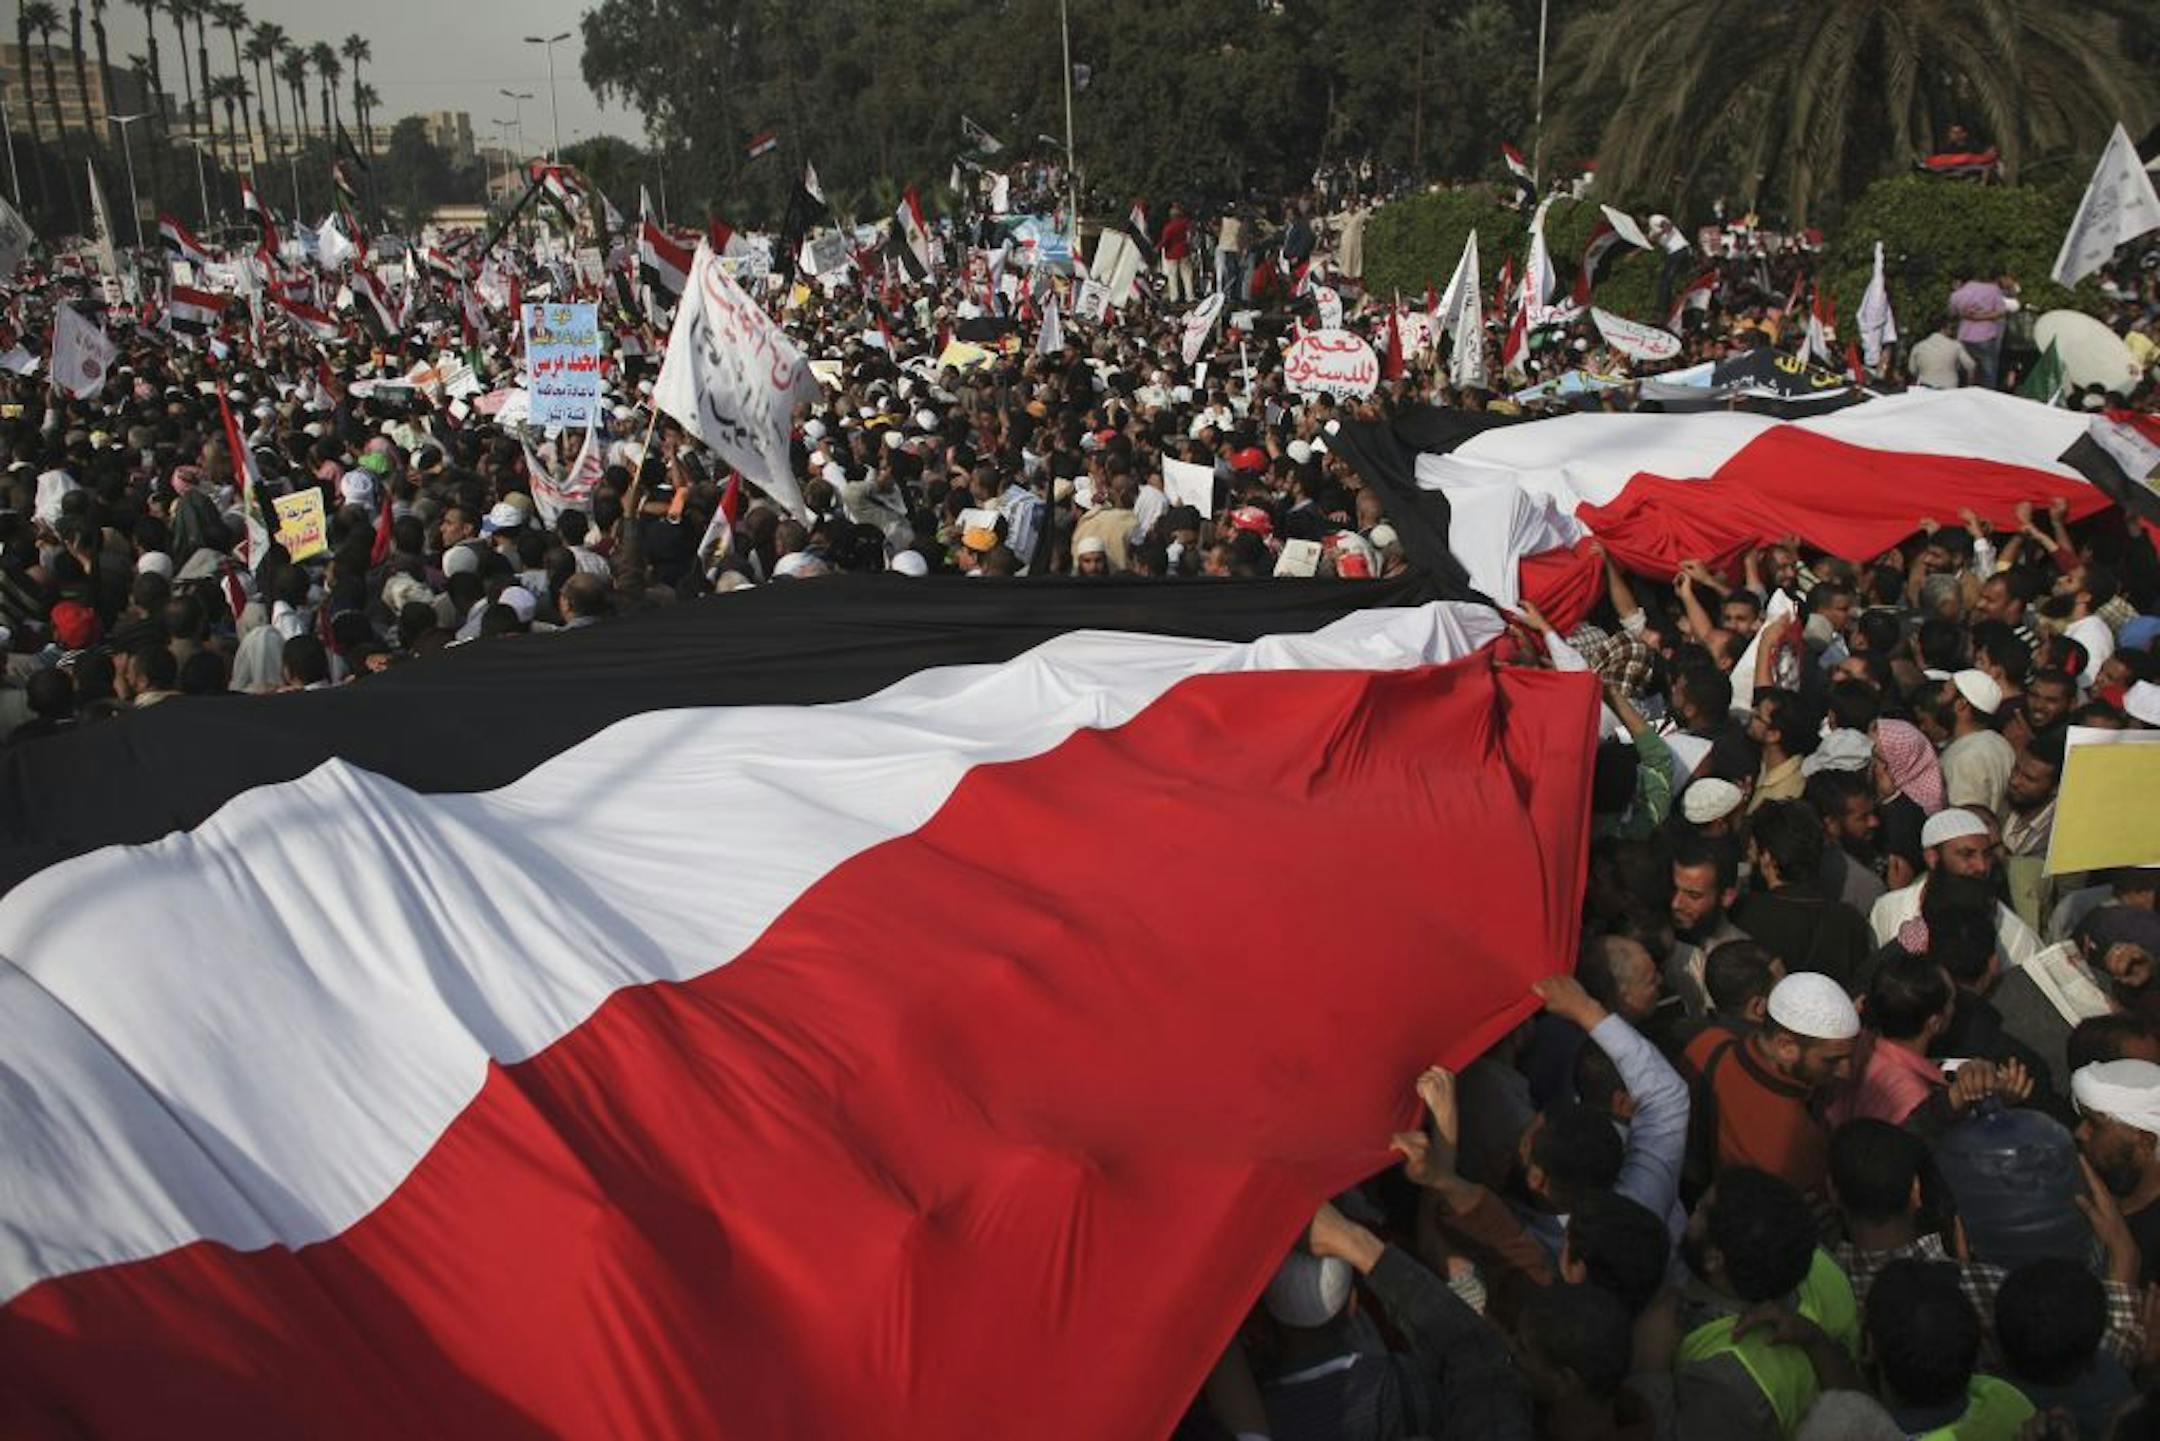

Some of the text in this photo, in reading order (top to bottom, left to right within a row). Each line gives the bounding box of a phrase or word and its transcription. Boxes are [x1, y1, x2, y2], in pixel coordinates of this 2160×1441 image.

[1301, 333, 1361, 356] نعم
[533, 351, 598, 378] محمد مرسي
[1284, 353, 1374, 384] للدستور
